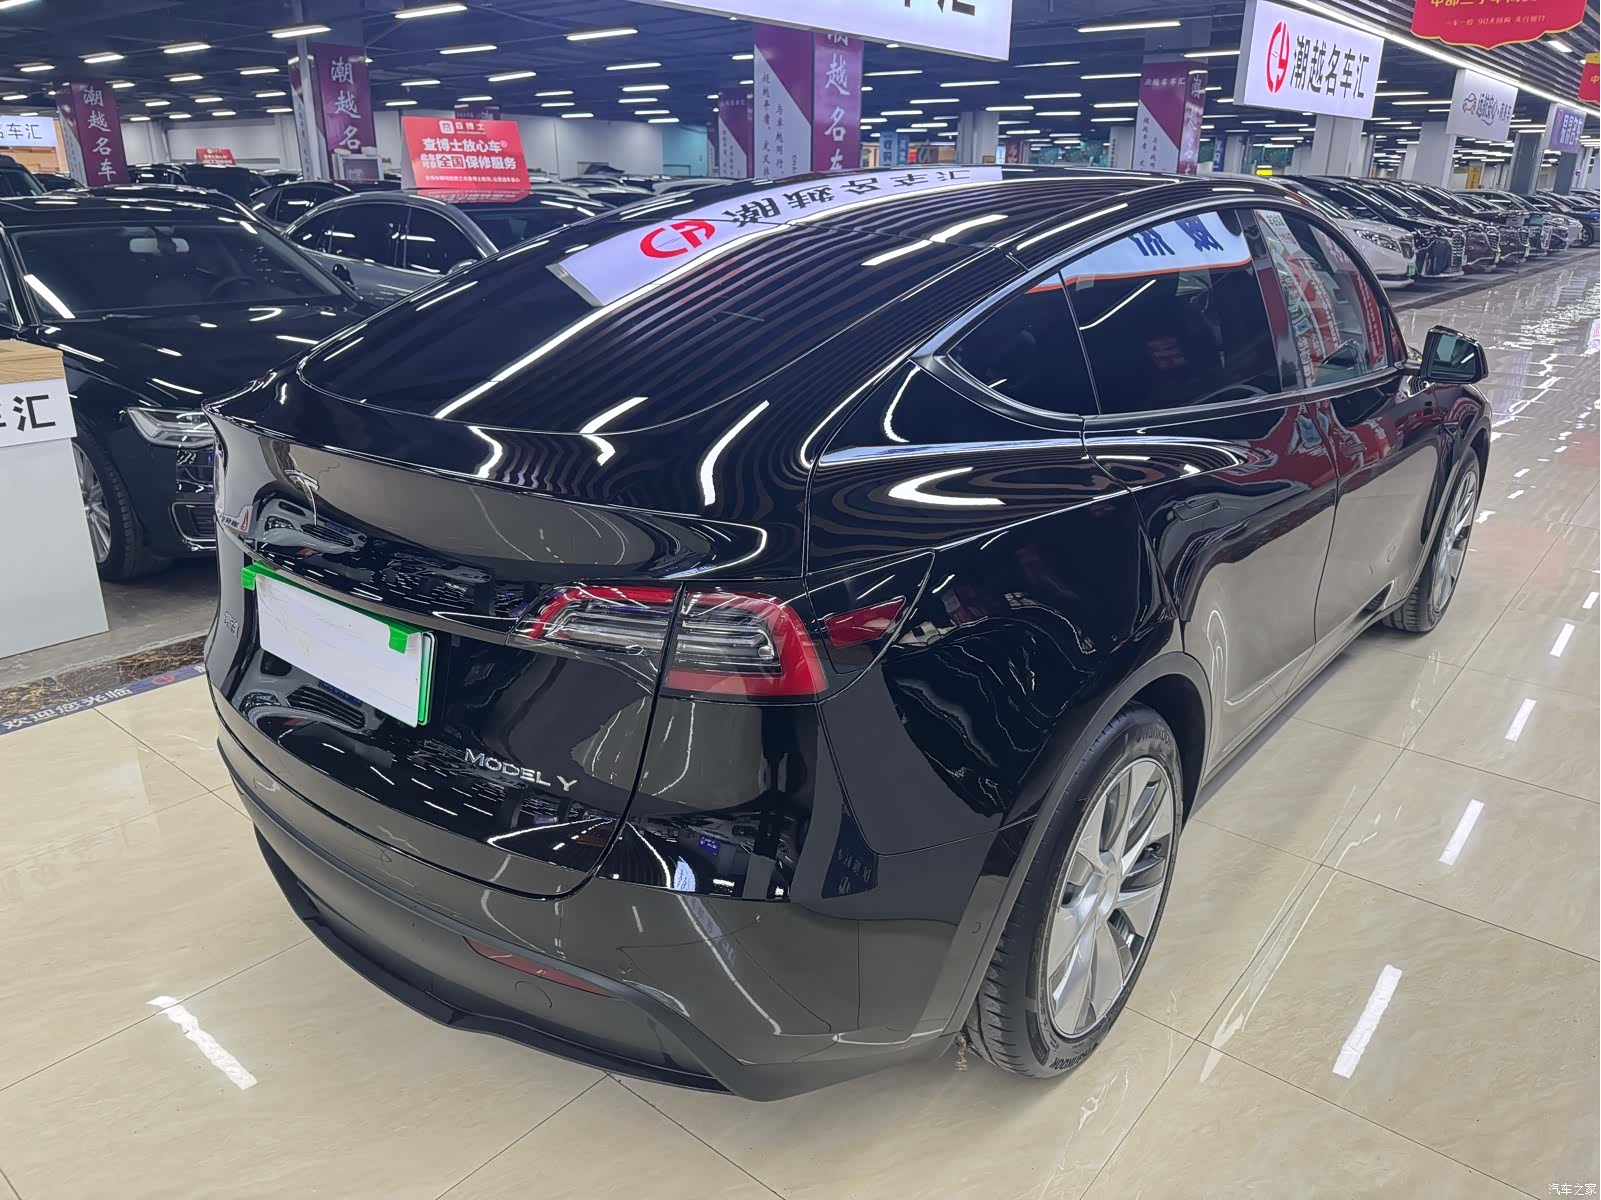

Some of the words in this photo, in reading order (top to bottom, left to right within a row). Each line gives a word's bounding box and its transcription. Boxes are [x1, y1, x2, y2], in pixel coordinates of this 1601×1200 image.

[1290, 35, 1370, 99] 潮越名车汇
[331, 56, 362, 150] 潮越名
[83, 86, 118, 181] 潮越名车
[0, 394, 56, 432] 汇
[2, 687, 134, 730] 欢迎您光临
[464, 747, 551, 787] MODEL
[556, 775, 578, 792] Y
